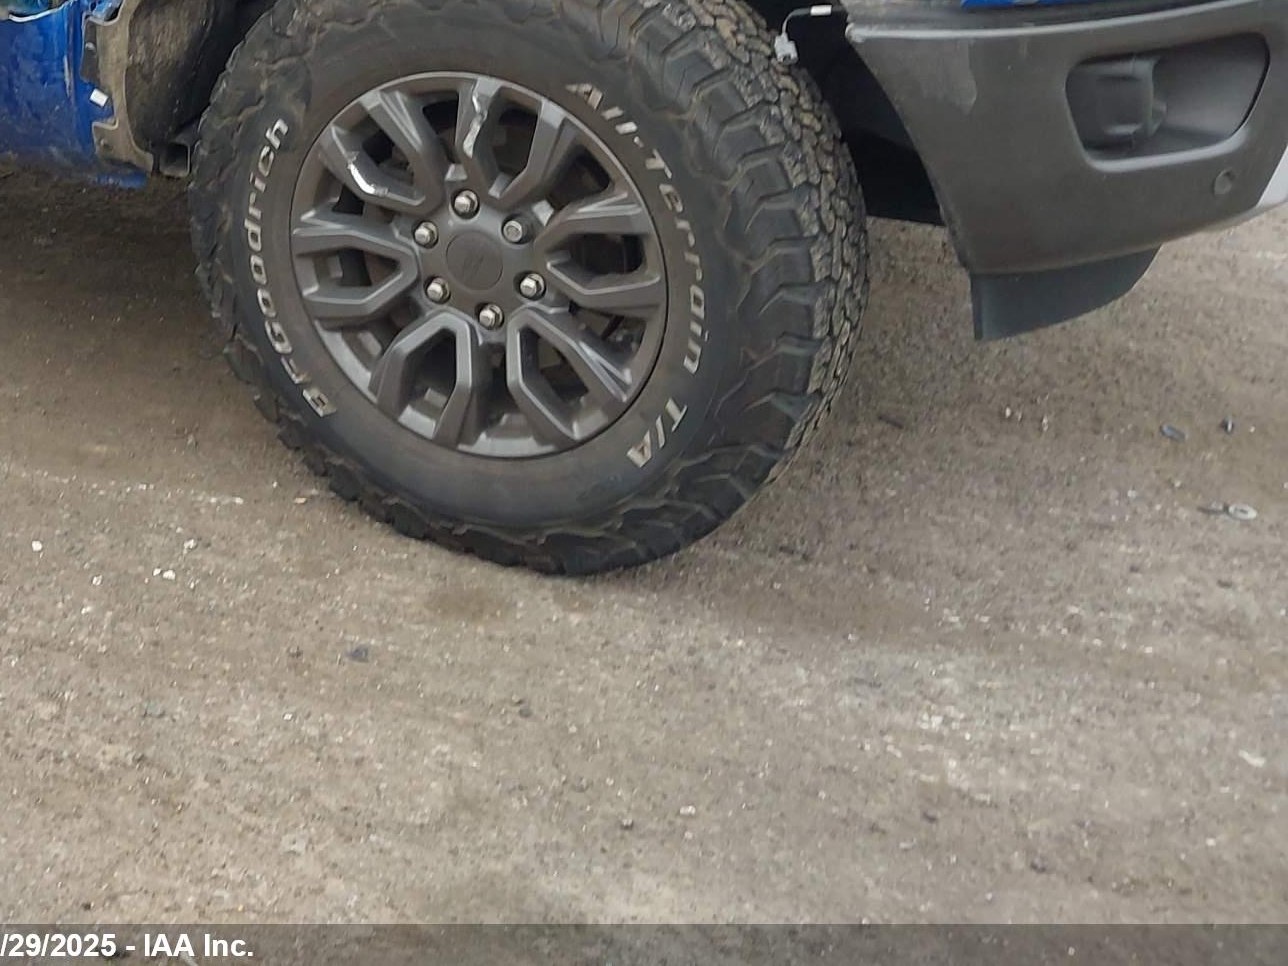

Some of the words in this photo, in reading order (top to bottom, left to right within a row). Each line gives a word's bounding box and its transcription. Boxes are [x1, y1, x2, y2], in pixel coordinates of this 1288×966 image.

[244, 118, 337, 418] BFGoodrich
[565, 83, 709, 375] All-Terrain
[626, 397, 688, 468] T/A
